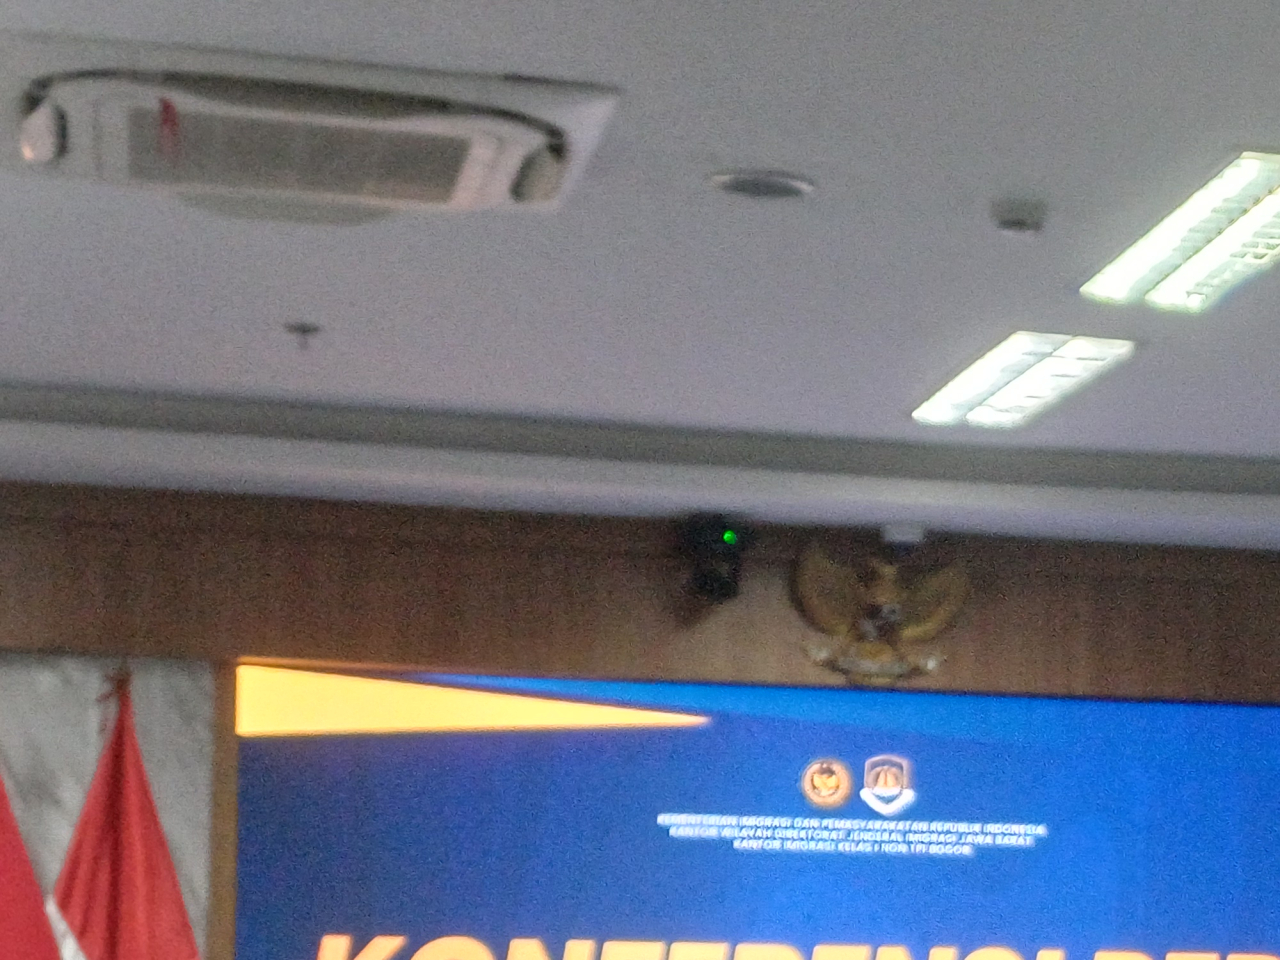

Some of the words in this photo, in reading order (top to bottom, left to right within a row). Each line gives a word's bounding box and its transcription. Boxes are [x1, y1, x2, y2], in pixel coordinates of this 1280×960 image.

[794, 817, 819, 830] DAN
[983, 823, 1048, 836] INDONESIA
[959, 834, 993, 846] JAWA
[881, 843, 910, 855] NON
[929, 844, 975, 857] BOGOR
